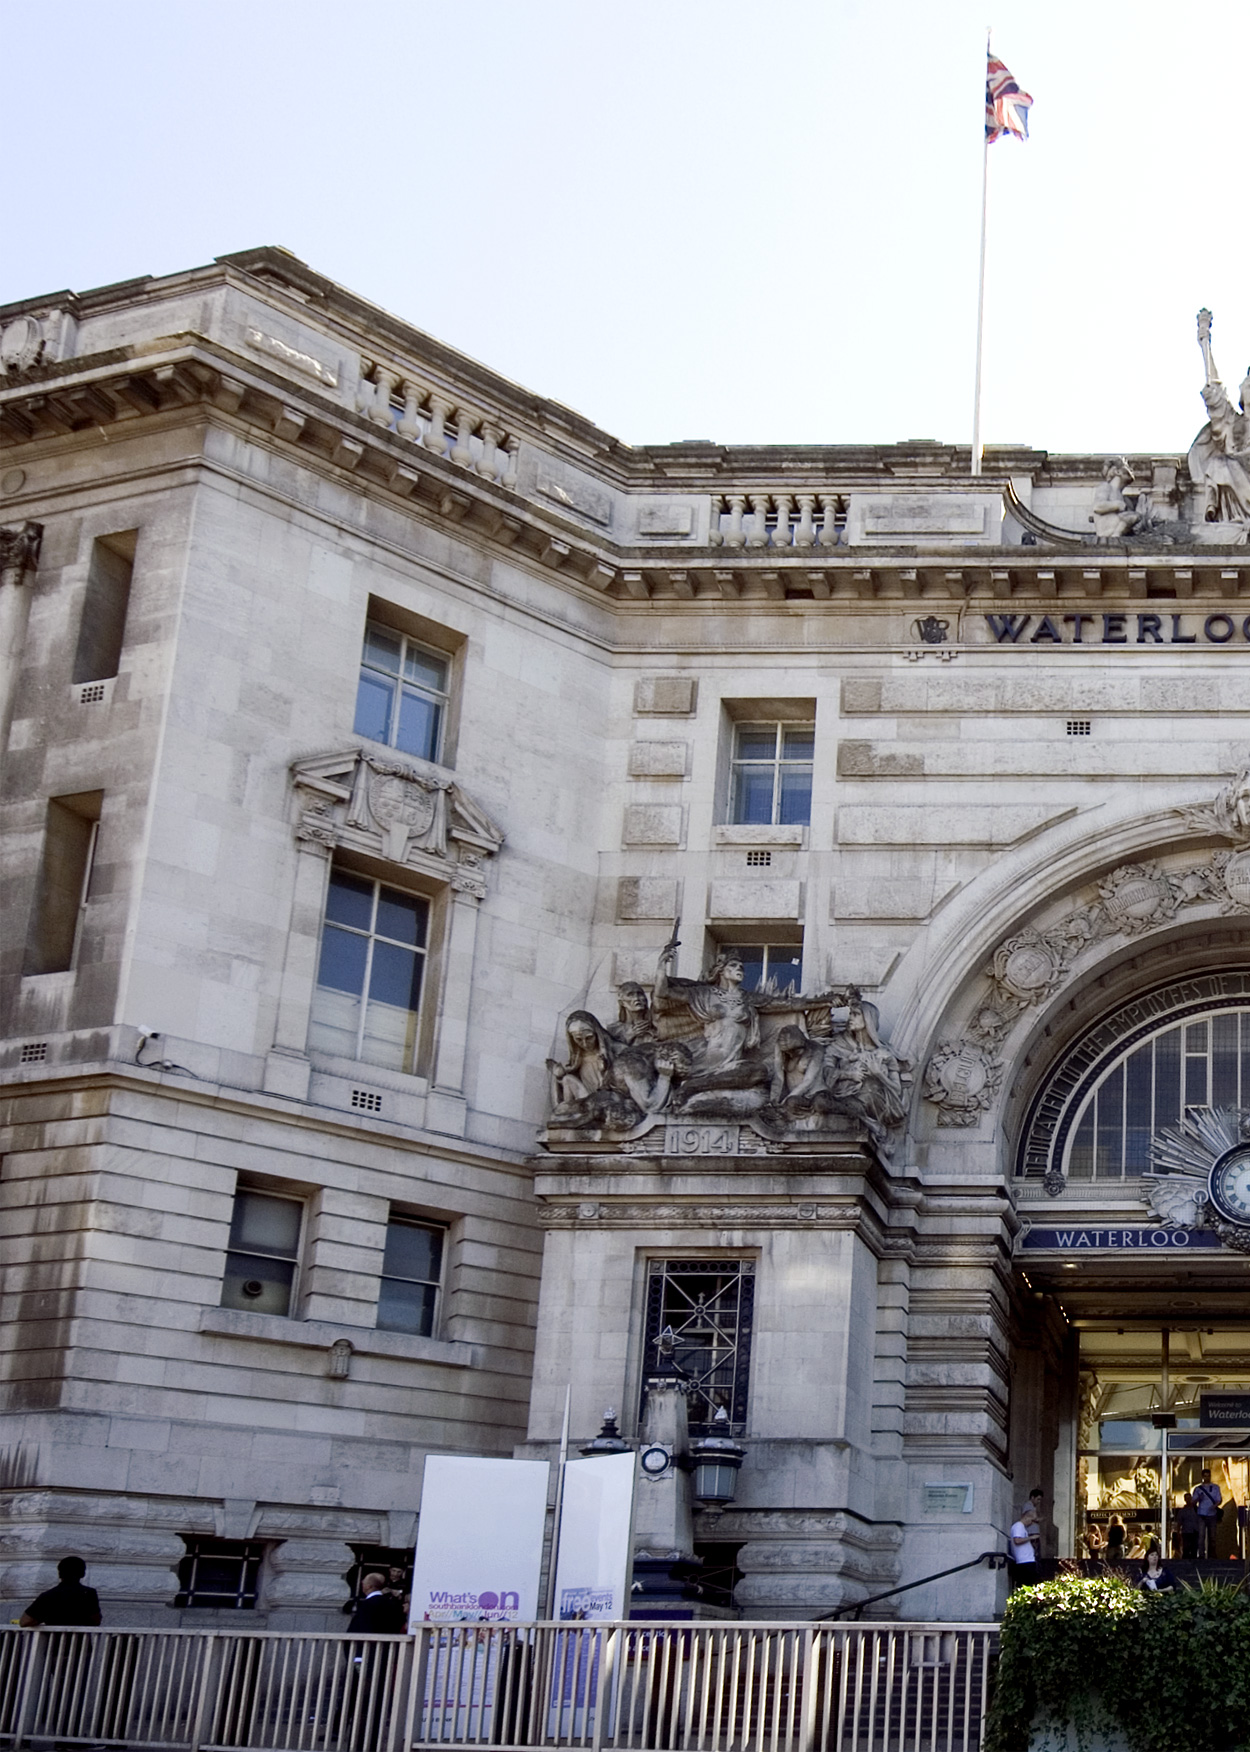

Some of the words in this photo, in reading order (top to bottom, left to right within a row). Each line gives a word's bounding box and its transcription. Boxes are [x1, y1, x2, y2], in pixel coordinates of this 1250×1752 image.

[1025, 1085, 1071, 1177] DEDICATED
[1054, 1064, 1084, 1087] TO
[1071, 1035, 1111, 1066] THE
[1105, 980, 1201, 1038] EMPLOYEES
[1209, 975, 1228, 996] OF
[670, 1129, 733, 1154] 1914
[1056, 1230, 1190, 1247] WATERLOO
[430, 1591, 478, 1603] What's
[590, 1602, 603, 1612] May
[604, 1601, 613, 1610] 12
